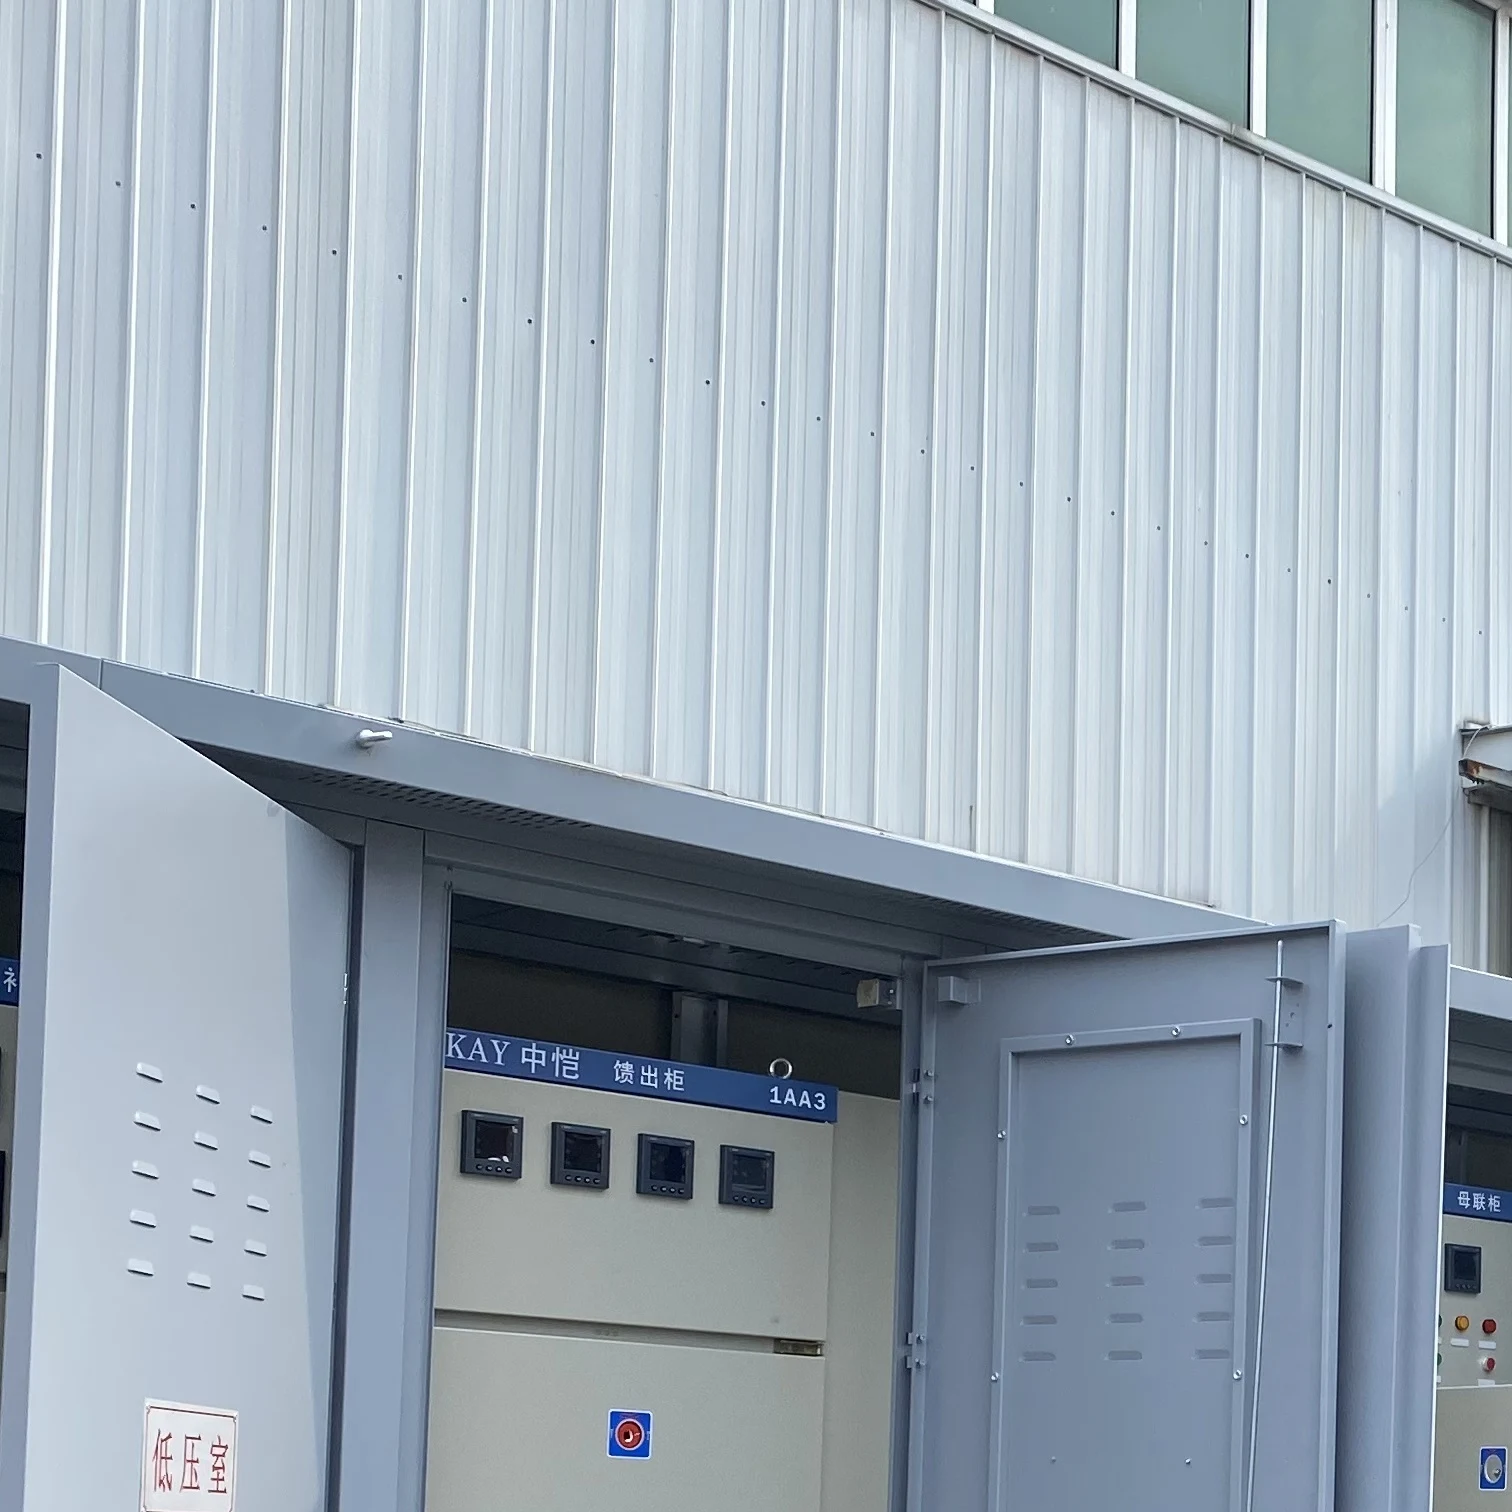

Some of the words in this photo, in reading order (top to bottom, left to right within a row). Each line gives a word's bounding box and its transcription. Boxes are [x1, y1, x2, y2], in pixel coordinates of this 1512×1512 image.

[521, 1042, 580, 1080] 中恺
[613, 1060, 685, 1091] 馈出柜
[769, 1086, 826, 1111] 1AA3
[1457, 1191, 1501, 1212] 母联柜
[152, 1428, 229, 1494] 低压室
